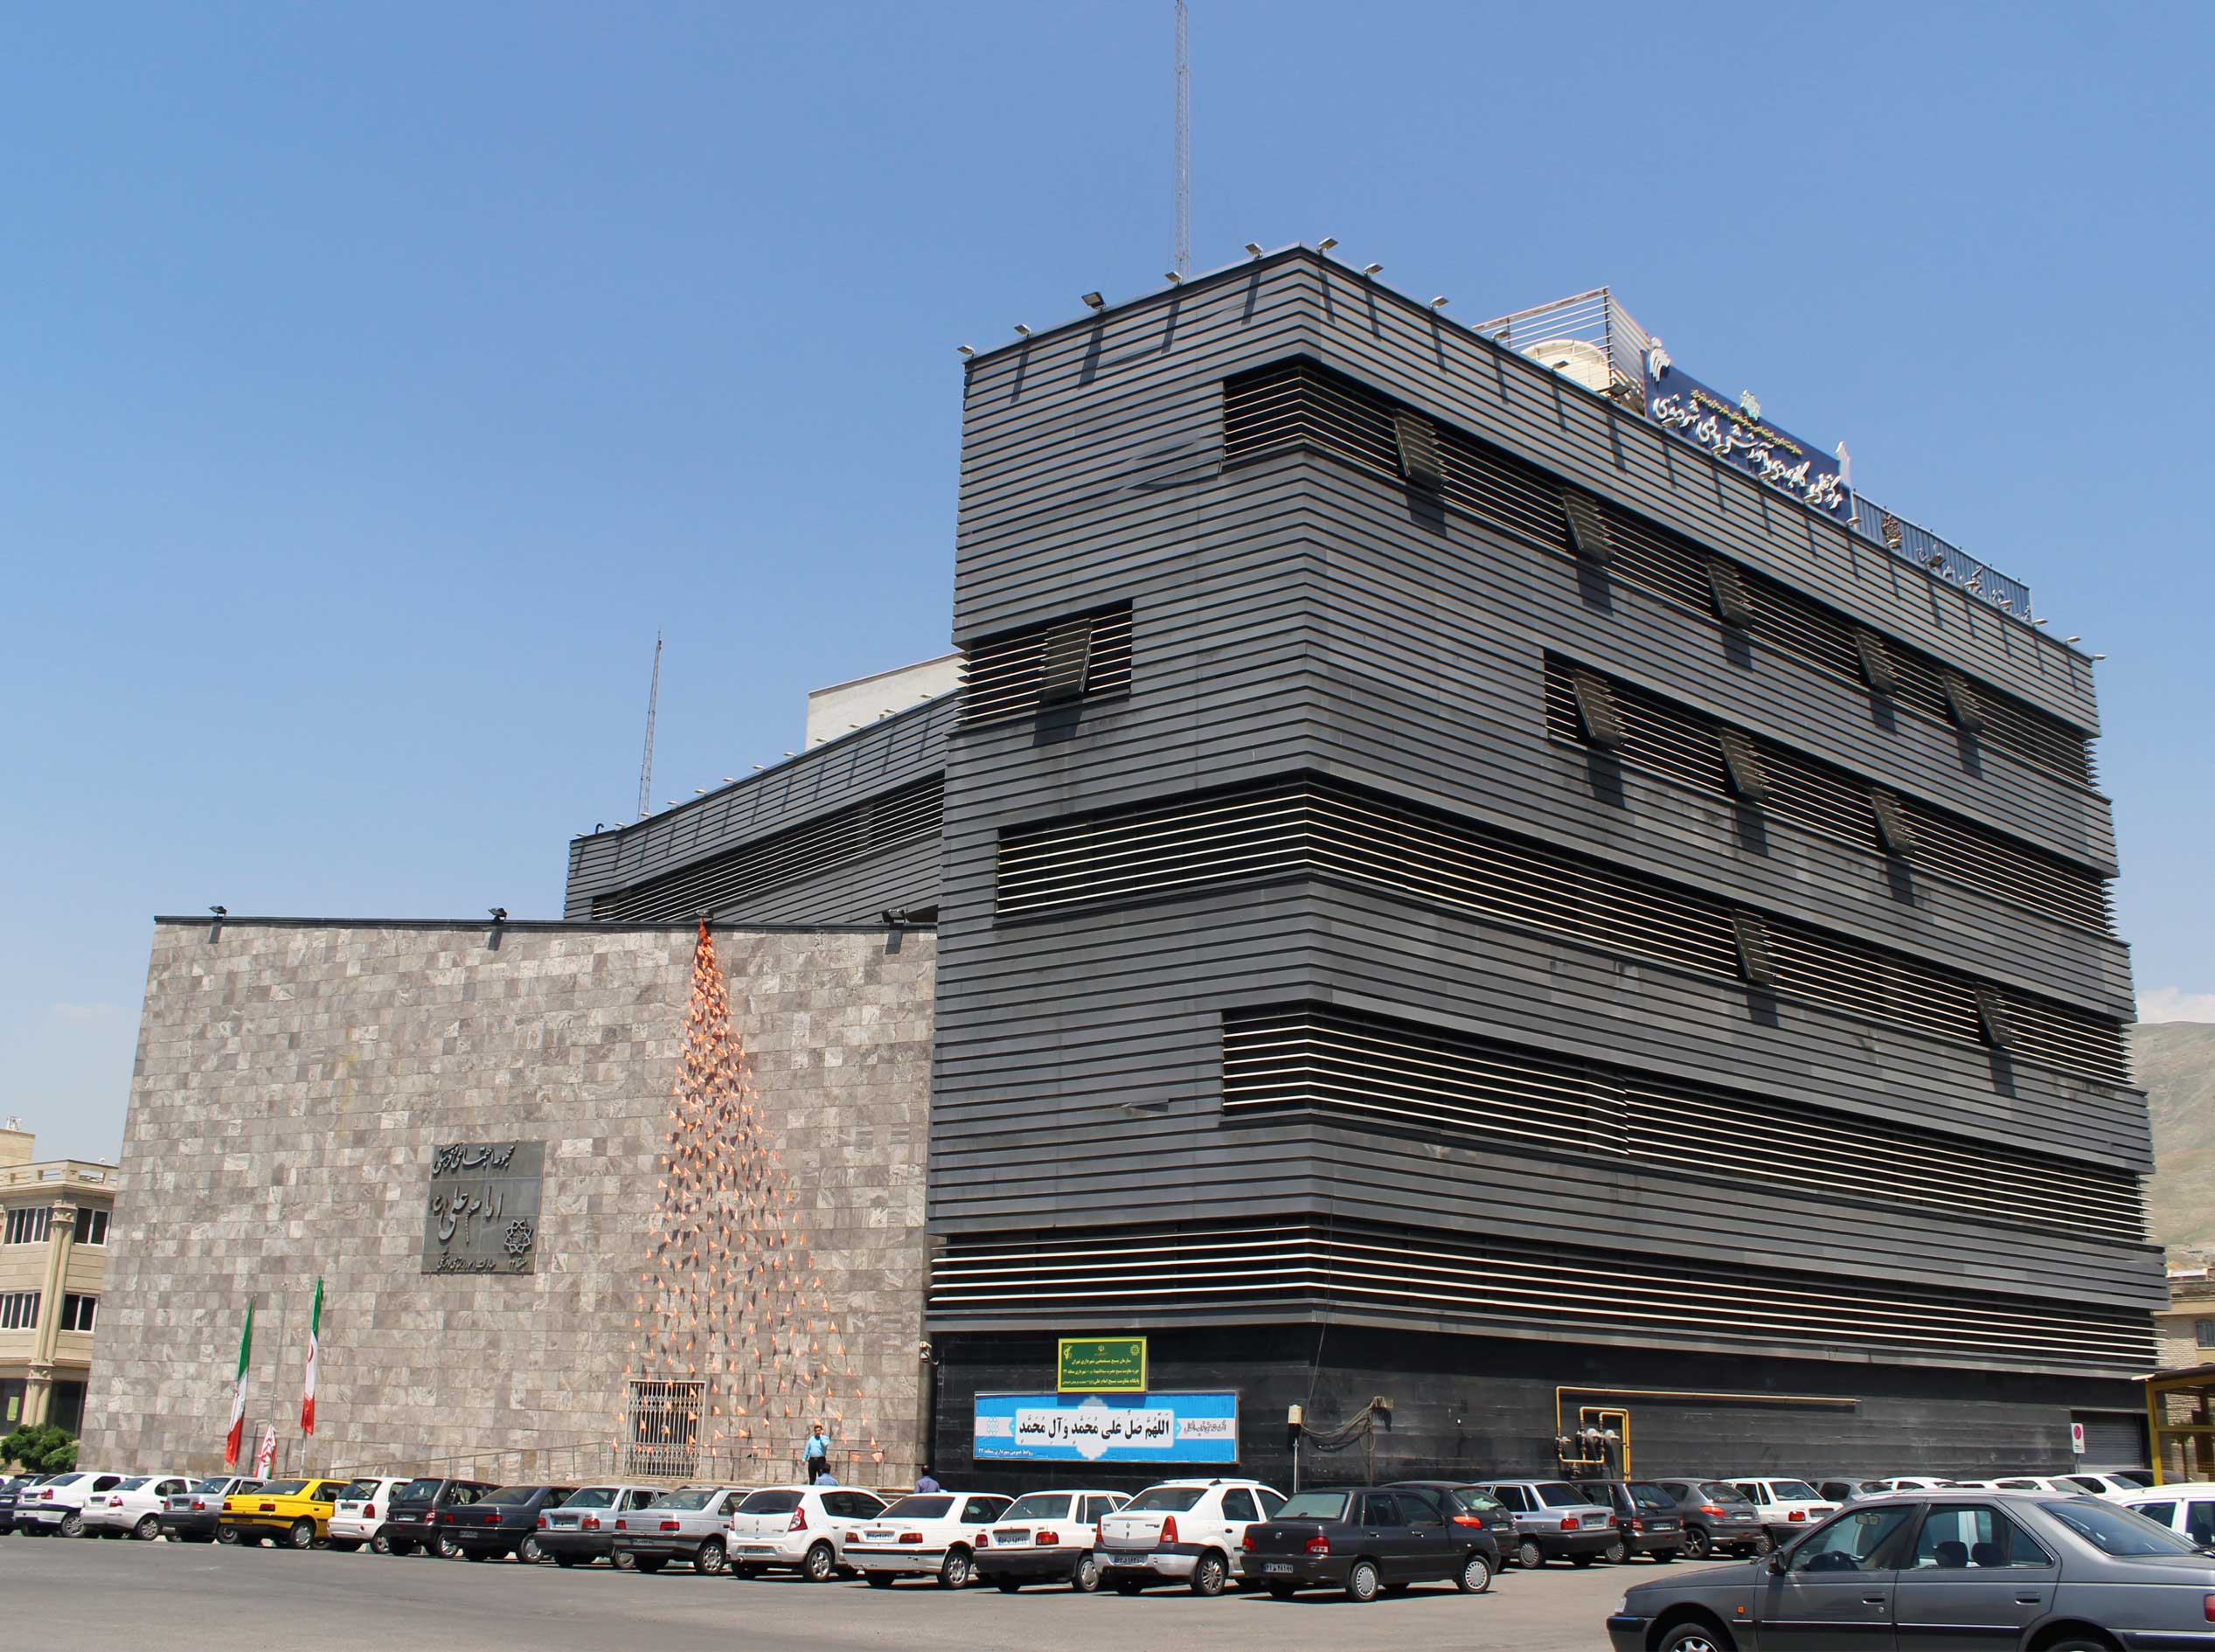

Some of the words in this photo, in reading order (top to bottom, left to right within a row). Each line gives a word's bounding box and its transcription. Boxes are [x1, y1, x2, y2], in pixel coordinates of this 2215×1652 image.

[1653, 393, 1700, 427] شهروندی
[451, 1146, 494, 1169] اجتماعی
[493, 1145, 515, 1168] مجموعه
[438, 1184, 469, 1241] علی
[464, 1185, 503, 1246] امام
